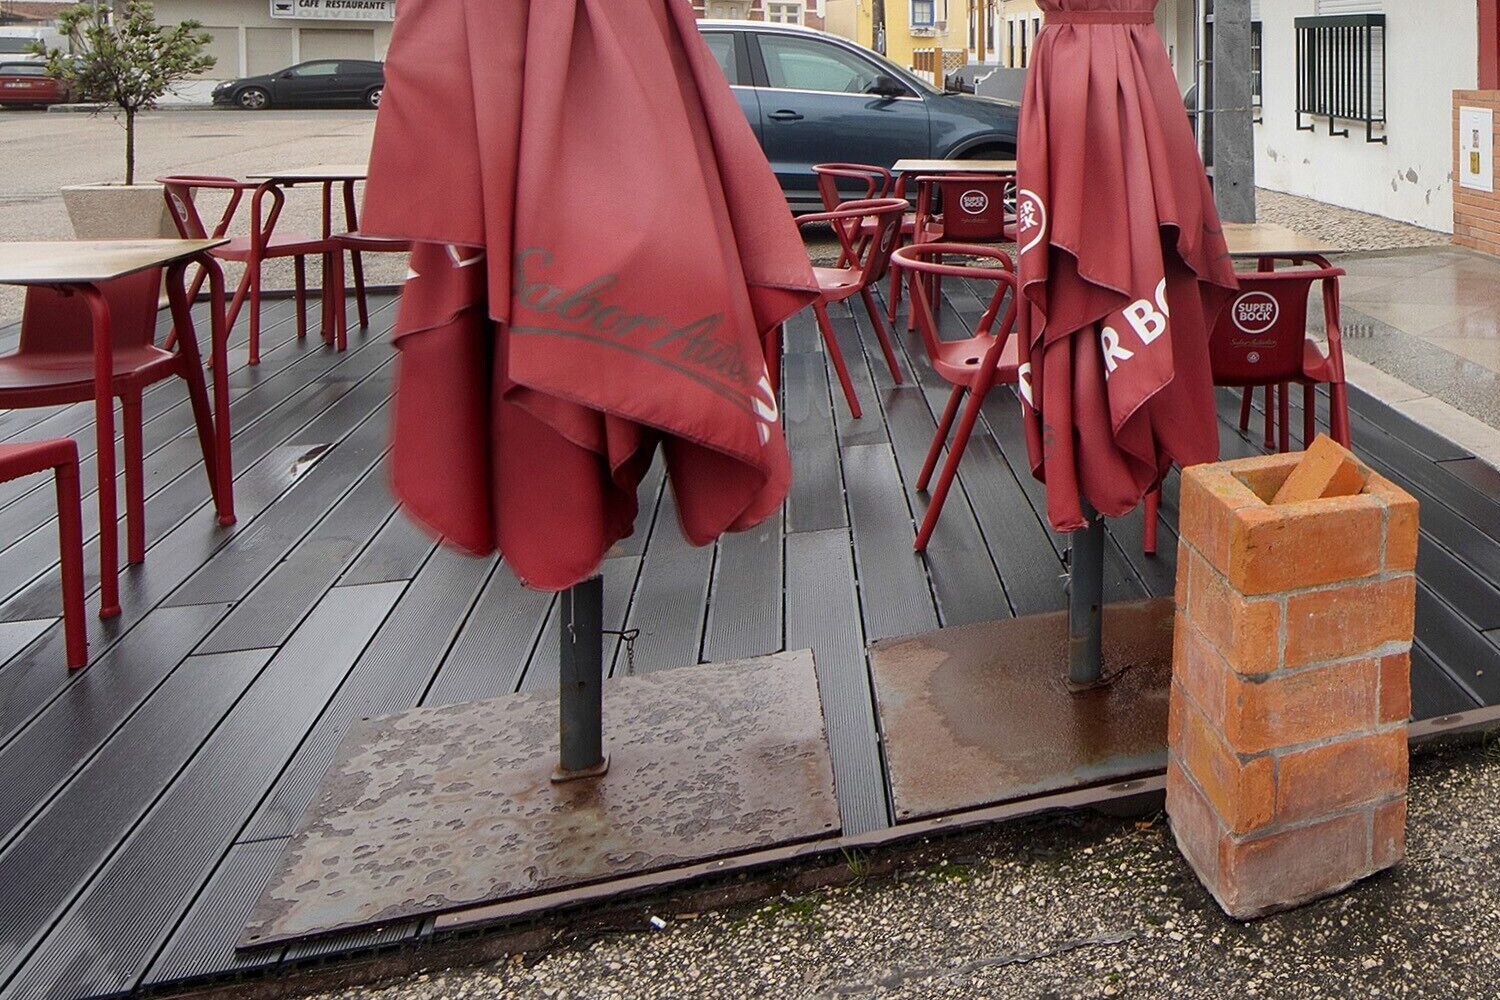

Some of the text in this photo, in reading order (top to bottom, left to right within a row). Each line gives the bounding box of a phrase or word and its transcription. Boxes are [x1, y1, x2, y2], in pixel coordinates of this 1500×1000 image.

[325, 0, 386, 10] RESTAURANTE
[515, 246, 660, 336] Sabor
[1238, 303, 1273, 312] SUPER
[1239, 312, 1271, 321] BOCK
